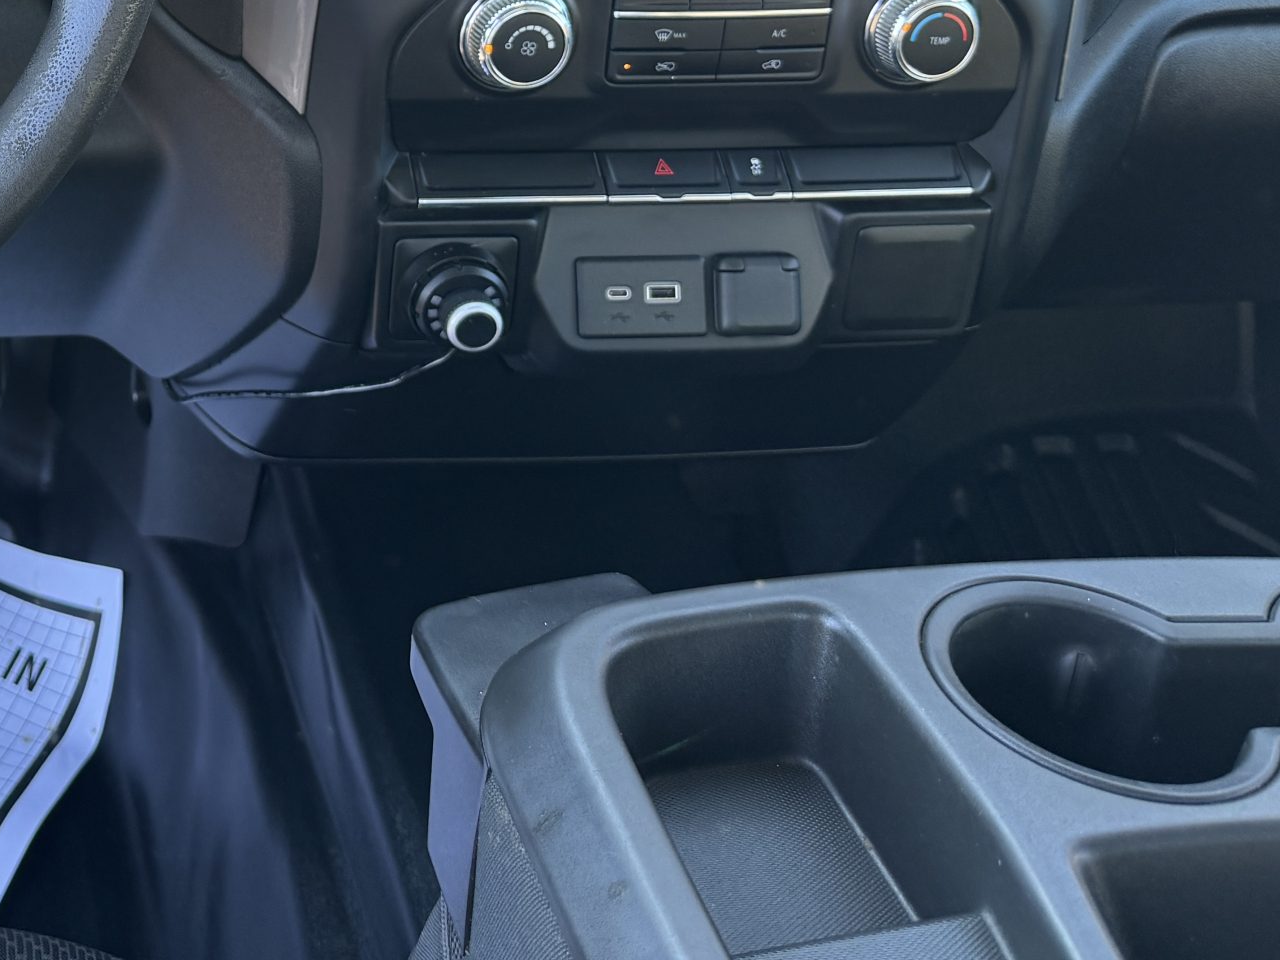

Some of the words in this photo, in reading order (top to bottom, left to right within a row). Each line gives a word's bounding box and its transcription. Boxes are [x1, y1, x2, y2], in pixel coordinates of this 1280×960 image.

[772, 29, 787, 38] A/C
[929, 36, 951, 45] TEMP
[1, 645, 48, 693] IN
